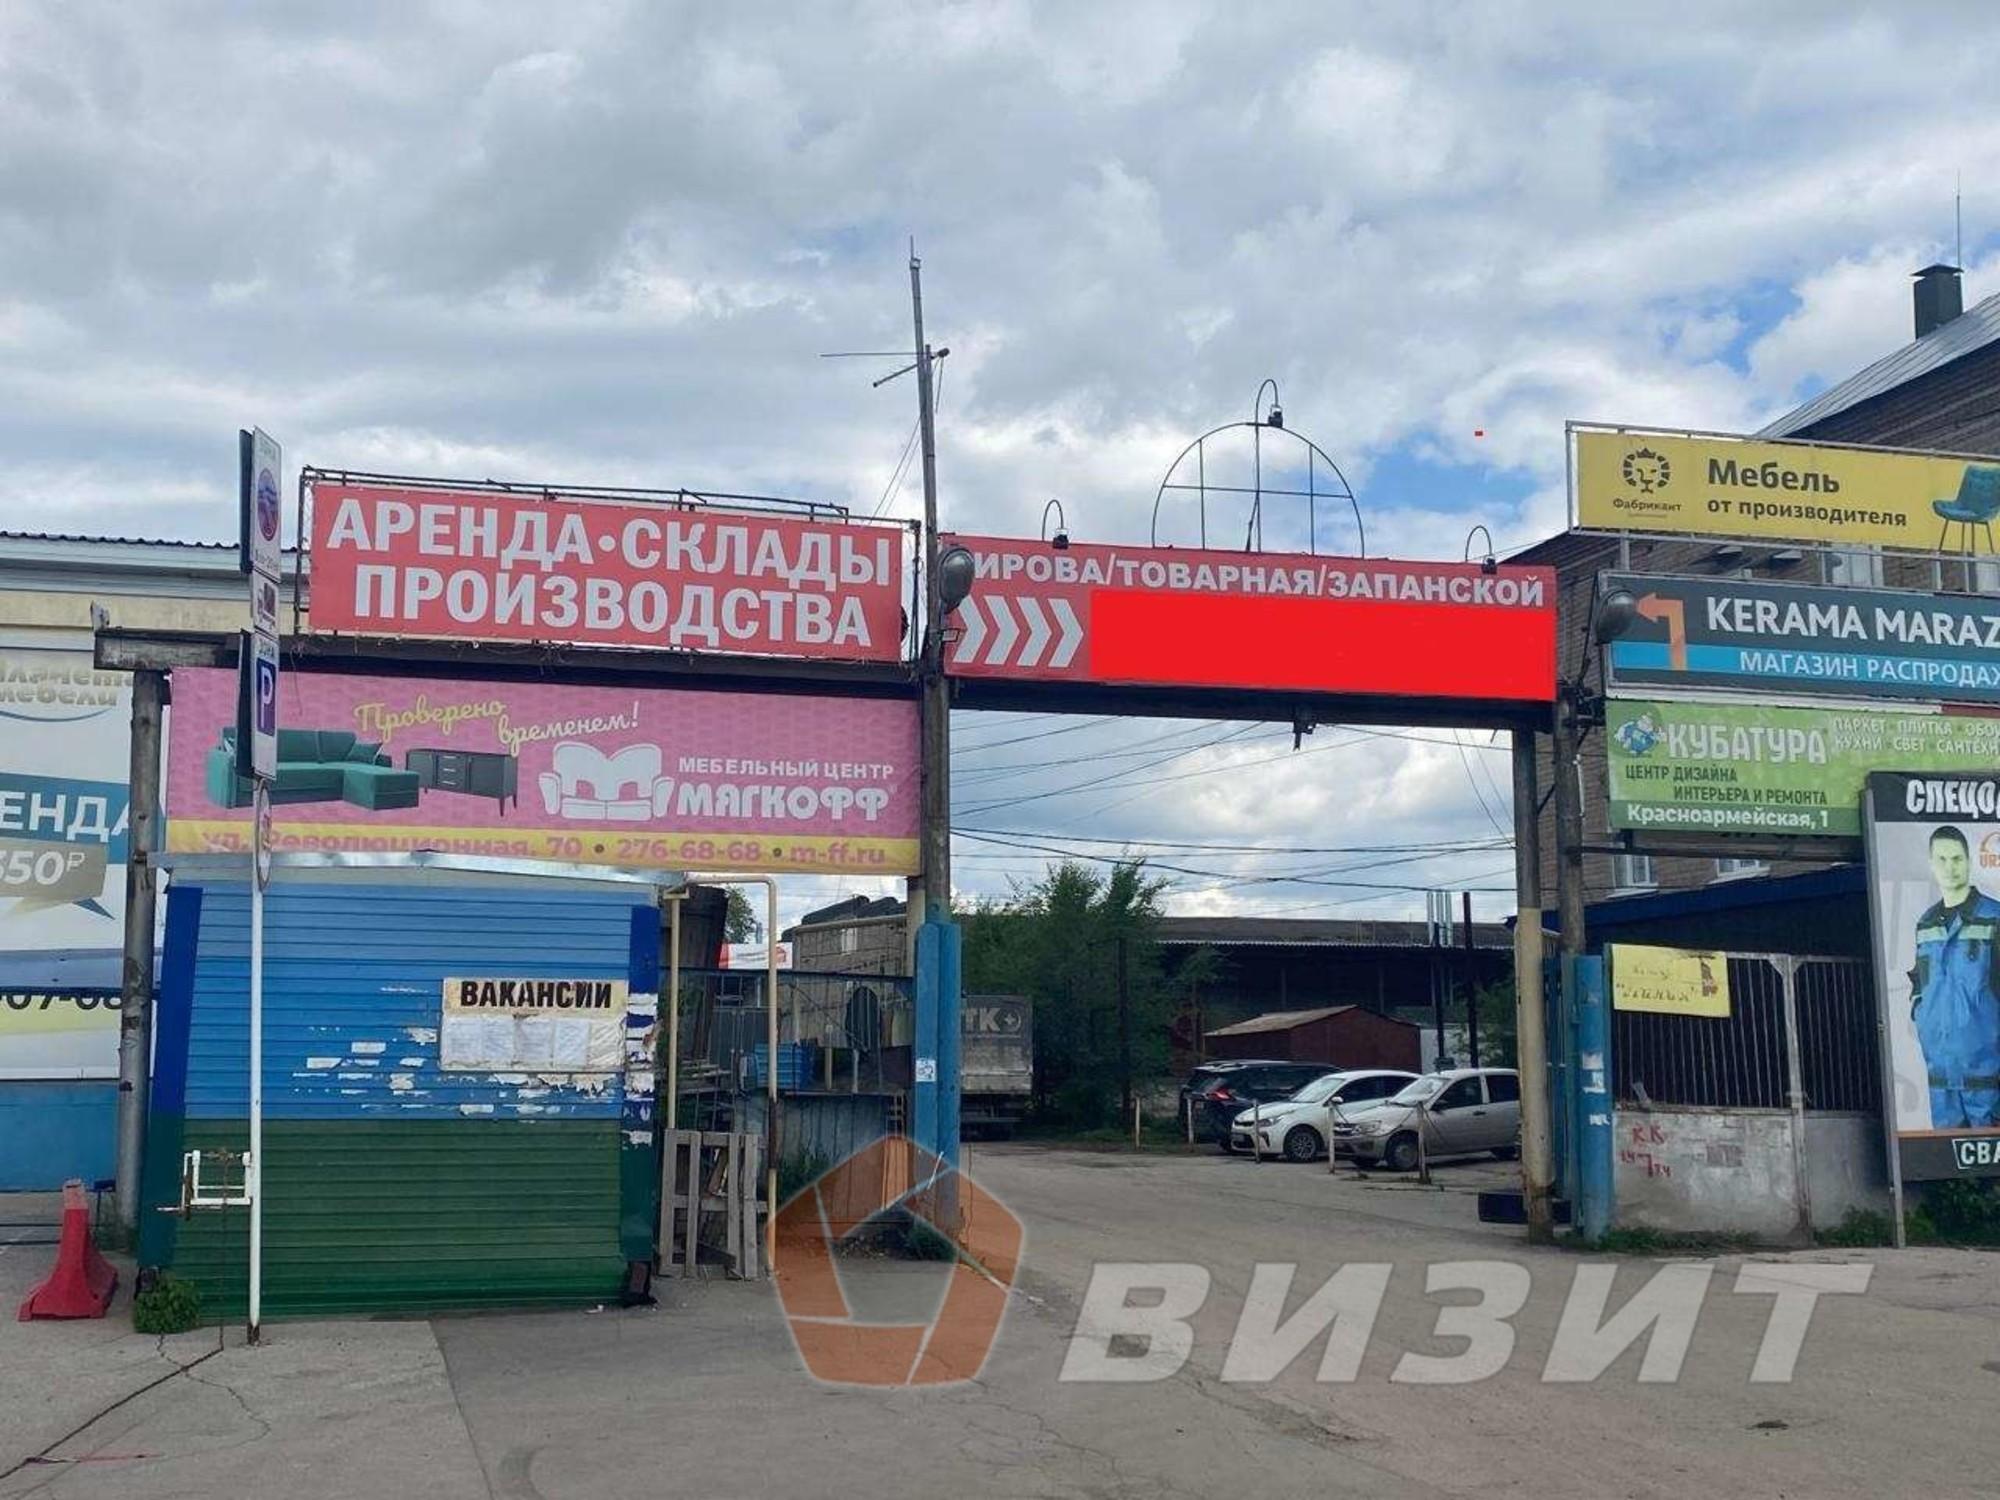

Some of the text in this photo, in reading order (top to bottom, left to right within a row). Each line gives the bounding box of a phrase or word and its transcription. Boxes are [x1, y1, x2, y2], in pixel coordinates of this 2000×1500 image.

[1708, 459, 1840, 493] Мебель
[1613, 498, 1682, 513] Фабрикант
[1708, 500, 1907, 527] от производителя
[974, 551, 1543, 607] ИРОВА/ТОВАРНАЯ/ЗАПАНСКОЙ
[354, 564, 872, 648] ПРОИЗВОДСТВА
[1706, 597, 1868, 641] KERAMA
[1740, 650, 1859, 677] МАГАЗИН
[355, 694, 506, 742] Проверено
[499, 701, 639, 757] временем!
[1834, 717, 1887, 733] ПАРКЕТ
[1898, 720, 1953, 735] ПЛИТКА
[1665, 723, 1827, 765] КУБАТУРА
[1834, 736, 1882, 751] КУХНИ
[1893, 737, 1925, 751] СВЕТ
[679, 756, 894, 780] МЕБЕЛЬНЫЙ ЦЕНТР
[1626, 764, 1737, 782] ЦЕНТР ДИЗАЙНА
[677, 783, 890, 821] МЯГКОФФ
[1674, 786, 1828, 806] ИНТЕРЬЕРА И РЕМОНТА
[1906, 779, 2000, 819] СПЕЦО
[1627, 804, 1828, 830] Красноармейская, 1
[546, 837, 583, 858] 70
[617, 838, 762, 862] 276-68-68
[790, 843, 885, 865] m-ff.ru
[460, 980, 612, 1009] ВАКАНСИИ
